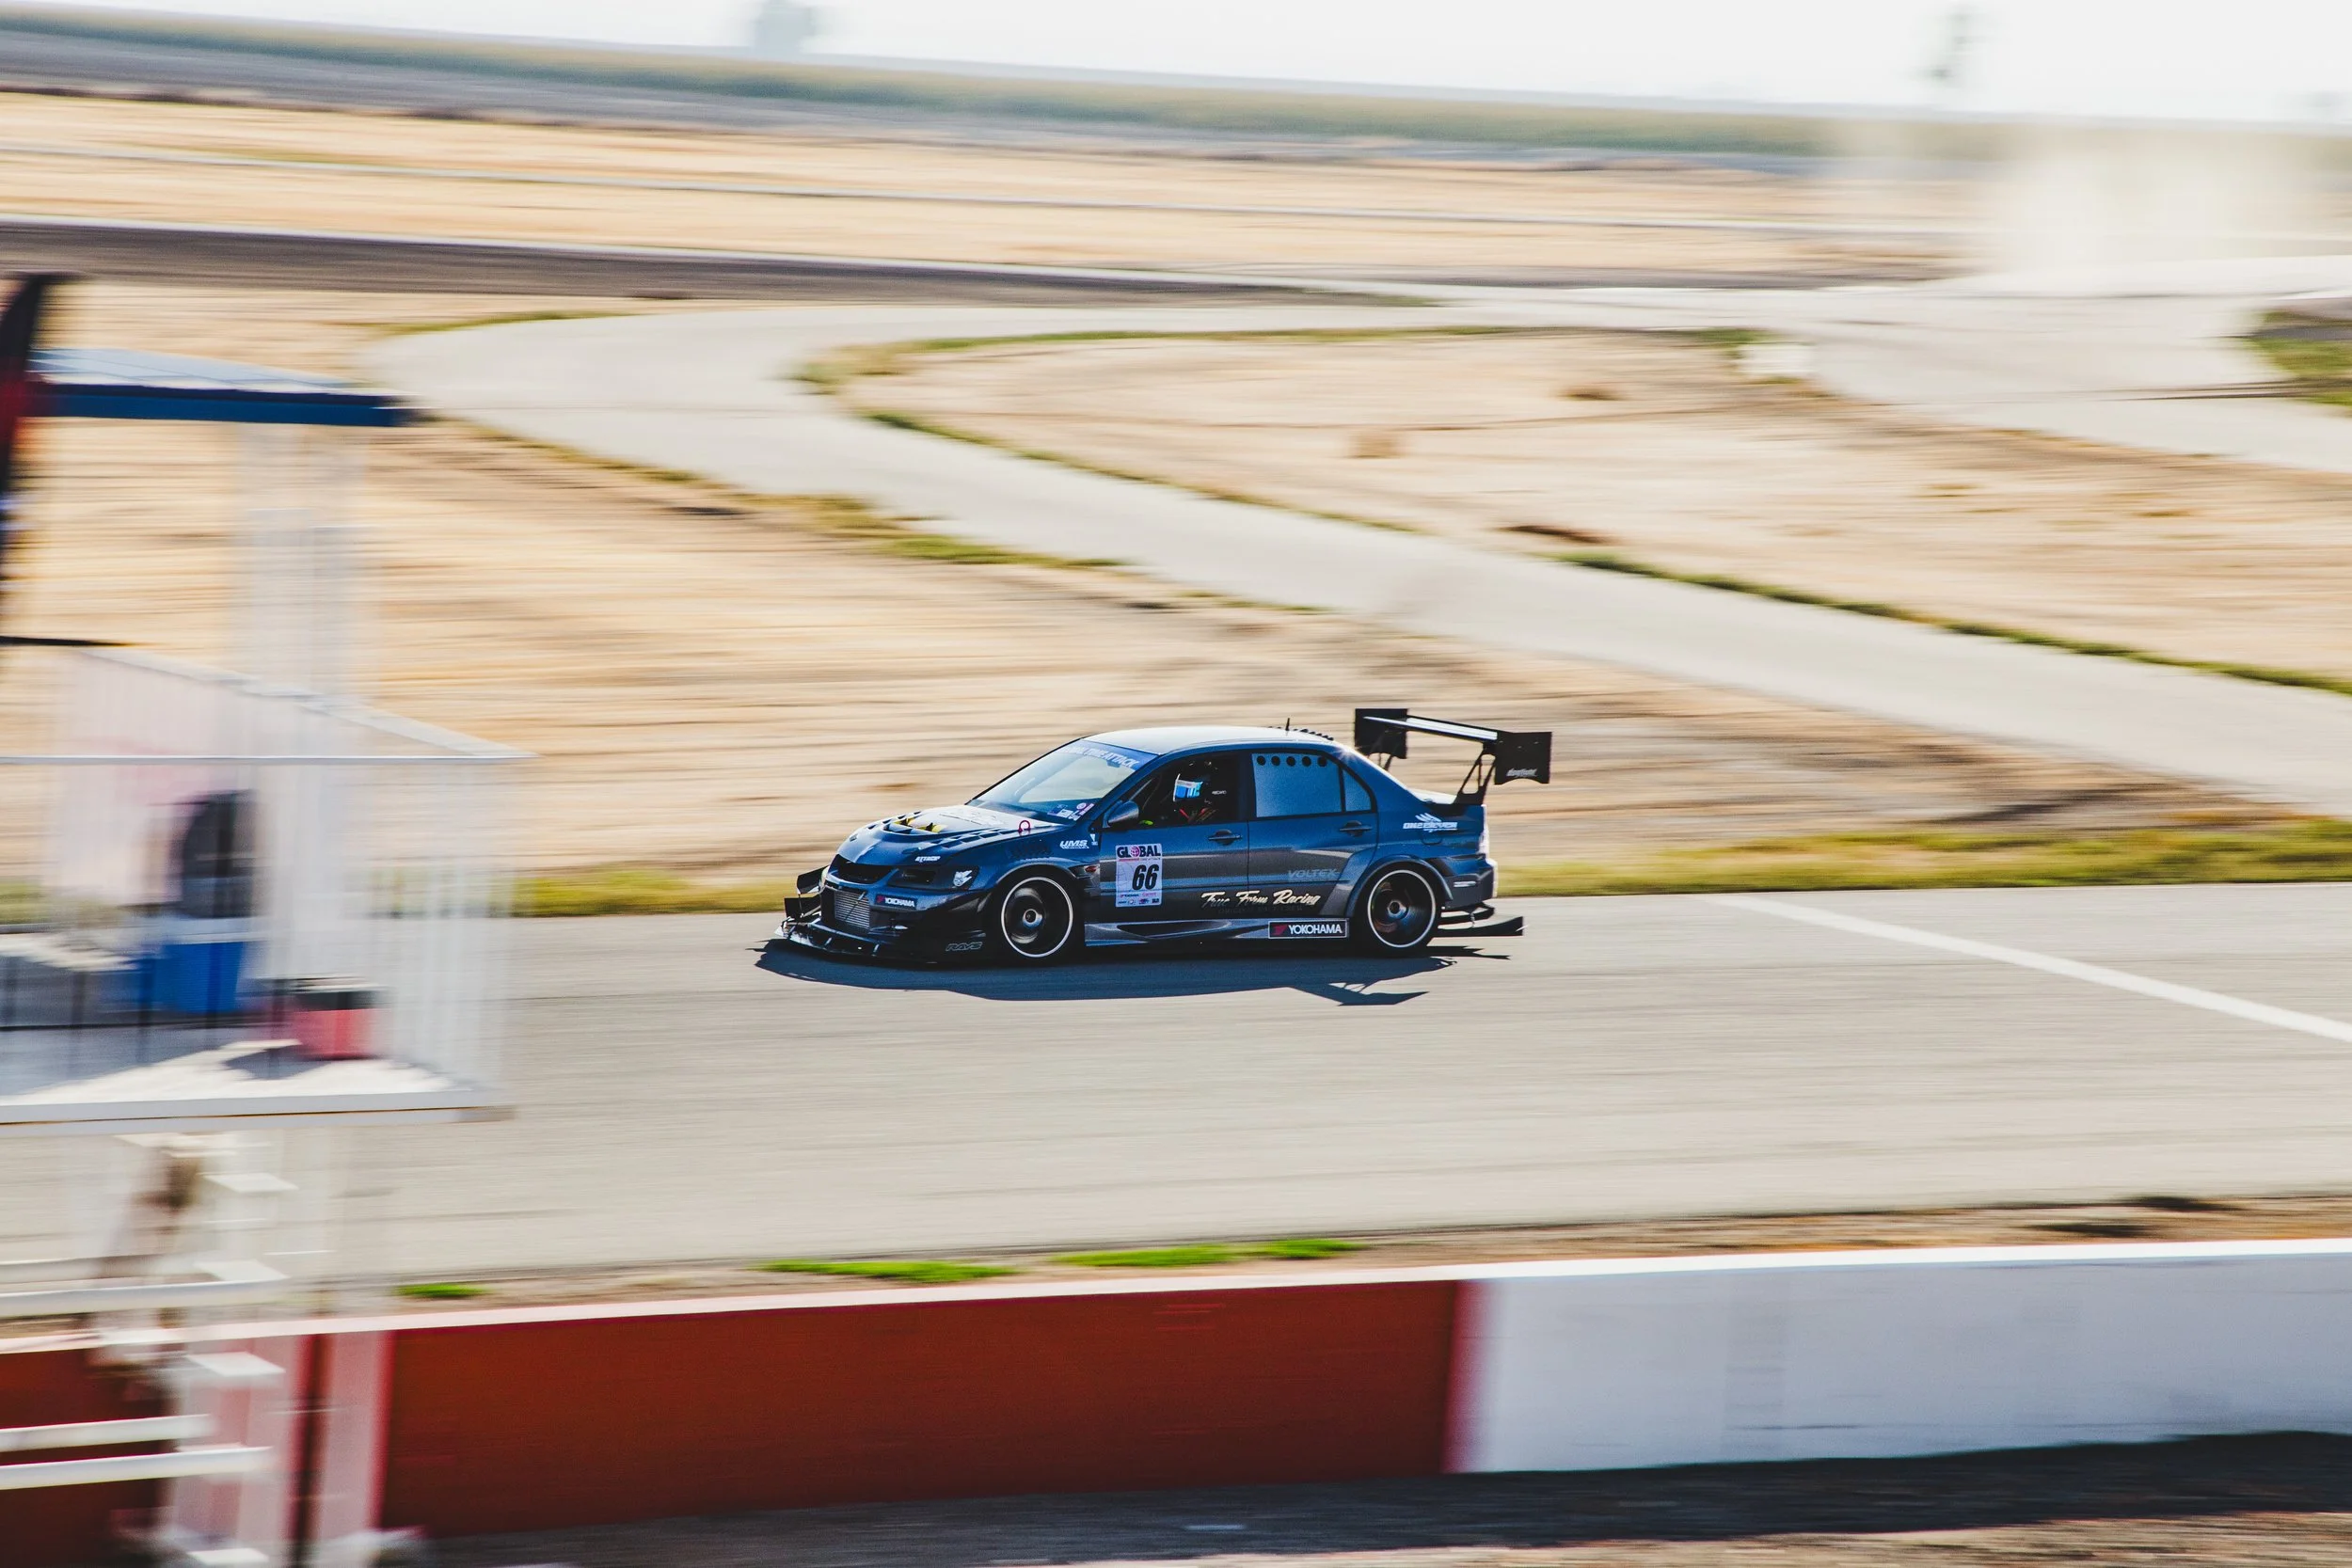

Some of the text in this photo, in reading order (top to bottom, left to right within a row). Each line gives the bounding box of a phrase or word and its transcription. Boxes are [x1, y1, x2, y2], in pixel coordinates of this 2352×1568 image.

[1116, 845, 1162, 858] GLOBAL
[1132, 863, 1160, 891] 66
[1287, 868, 1341, 879] VOLTEX
[884, 896, 915, 908] YOKOHAMA
[1200, 889, 1321, 909] True Form Racing
[1288, 924, 1343, 934] YOKOHAMA
[945, 942, 983, 951] RAYS
